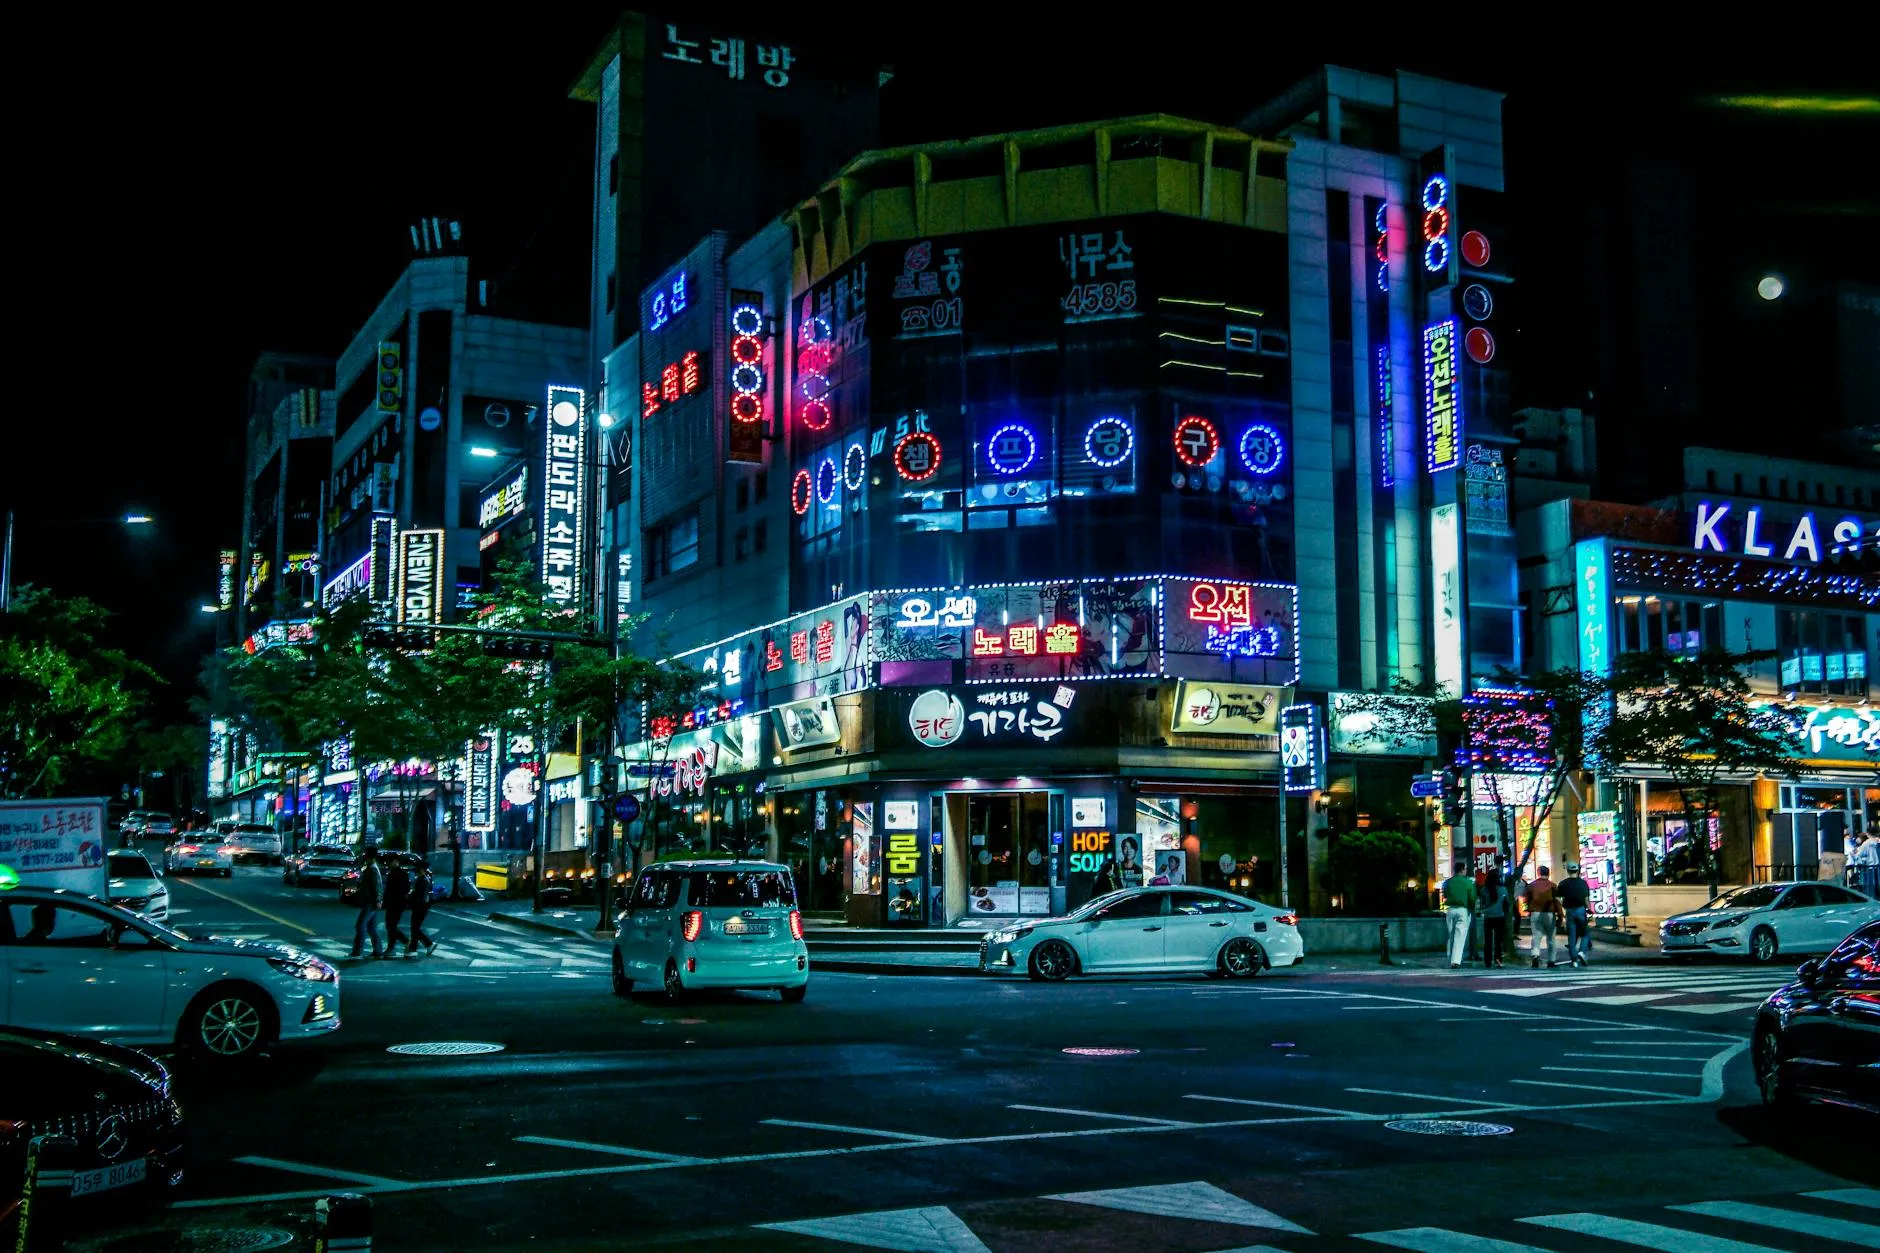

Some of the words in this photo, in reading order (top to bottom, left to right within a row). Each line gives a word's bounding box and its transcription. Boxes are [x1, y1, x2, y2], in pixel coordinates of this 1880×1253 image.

[661, 23, 796, 88] 노래방
[1066, 280, 1138, 315] 4585
[550, 434, 578, 515] 판도라
[886, 834, 921, 874] 룸
[1072, 831, 1110, 852] HOF
